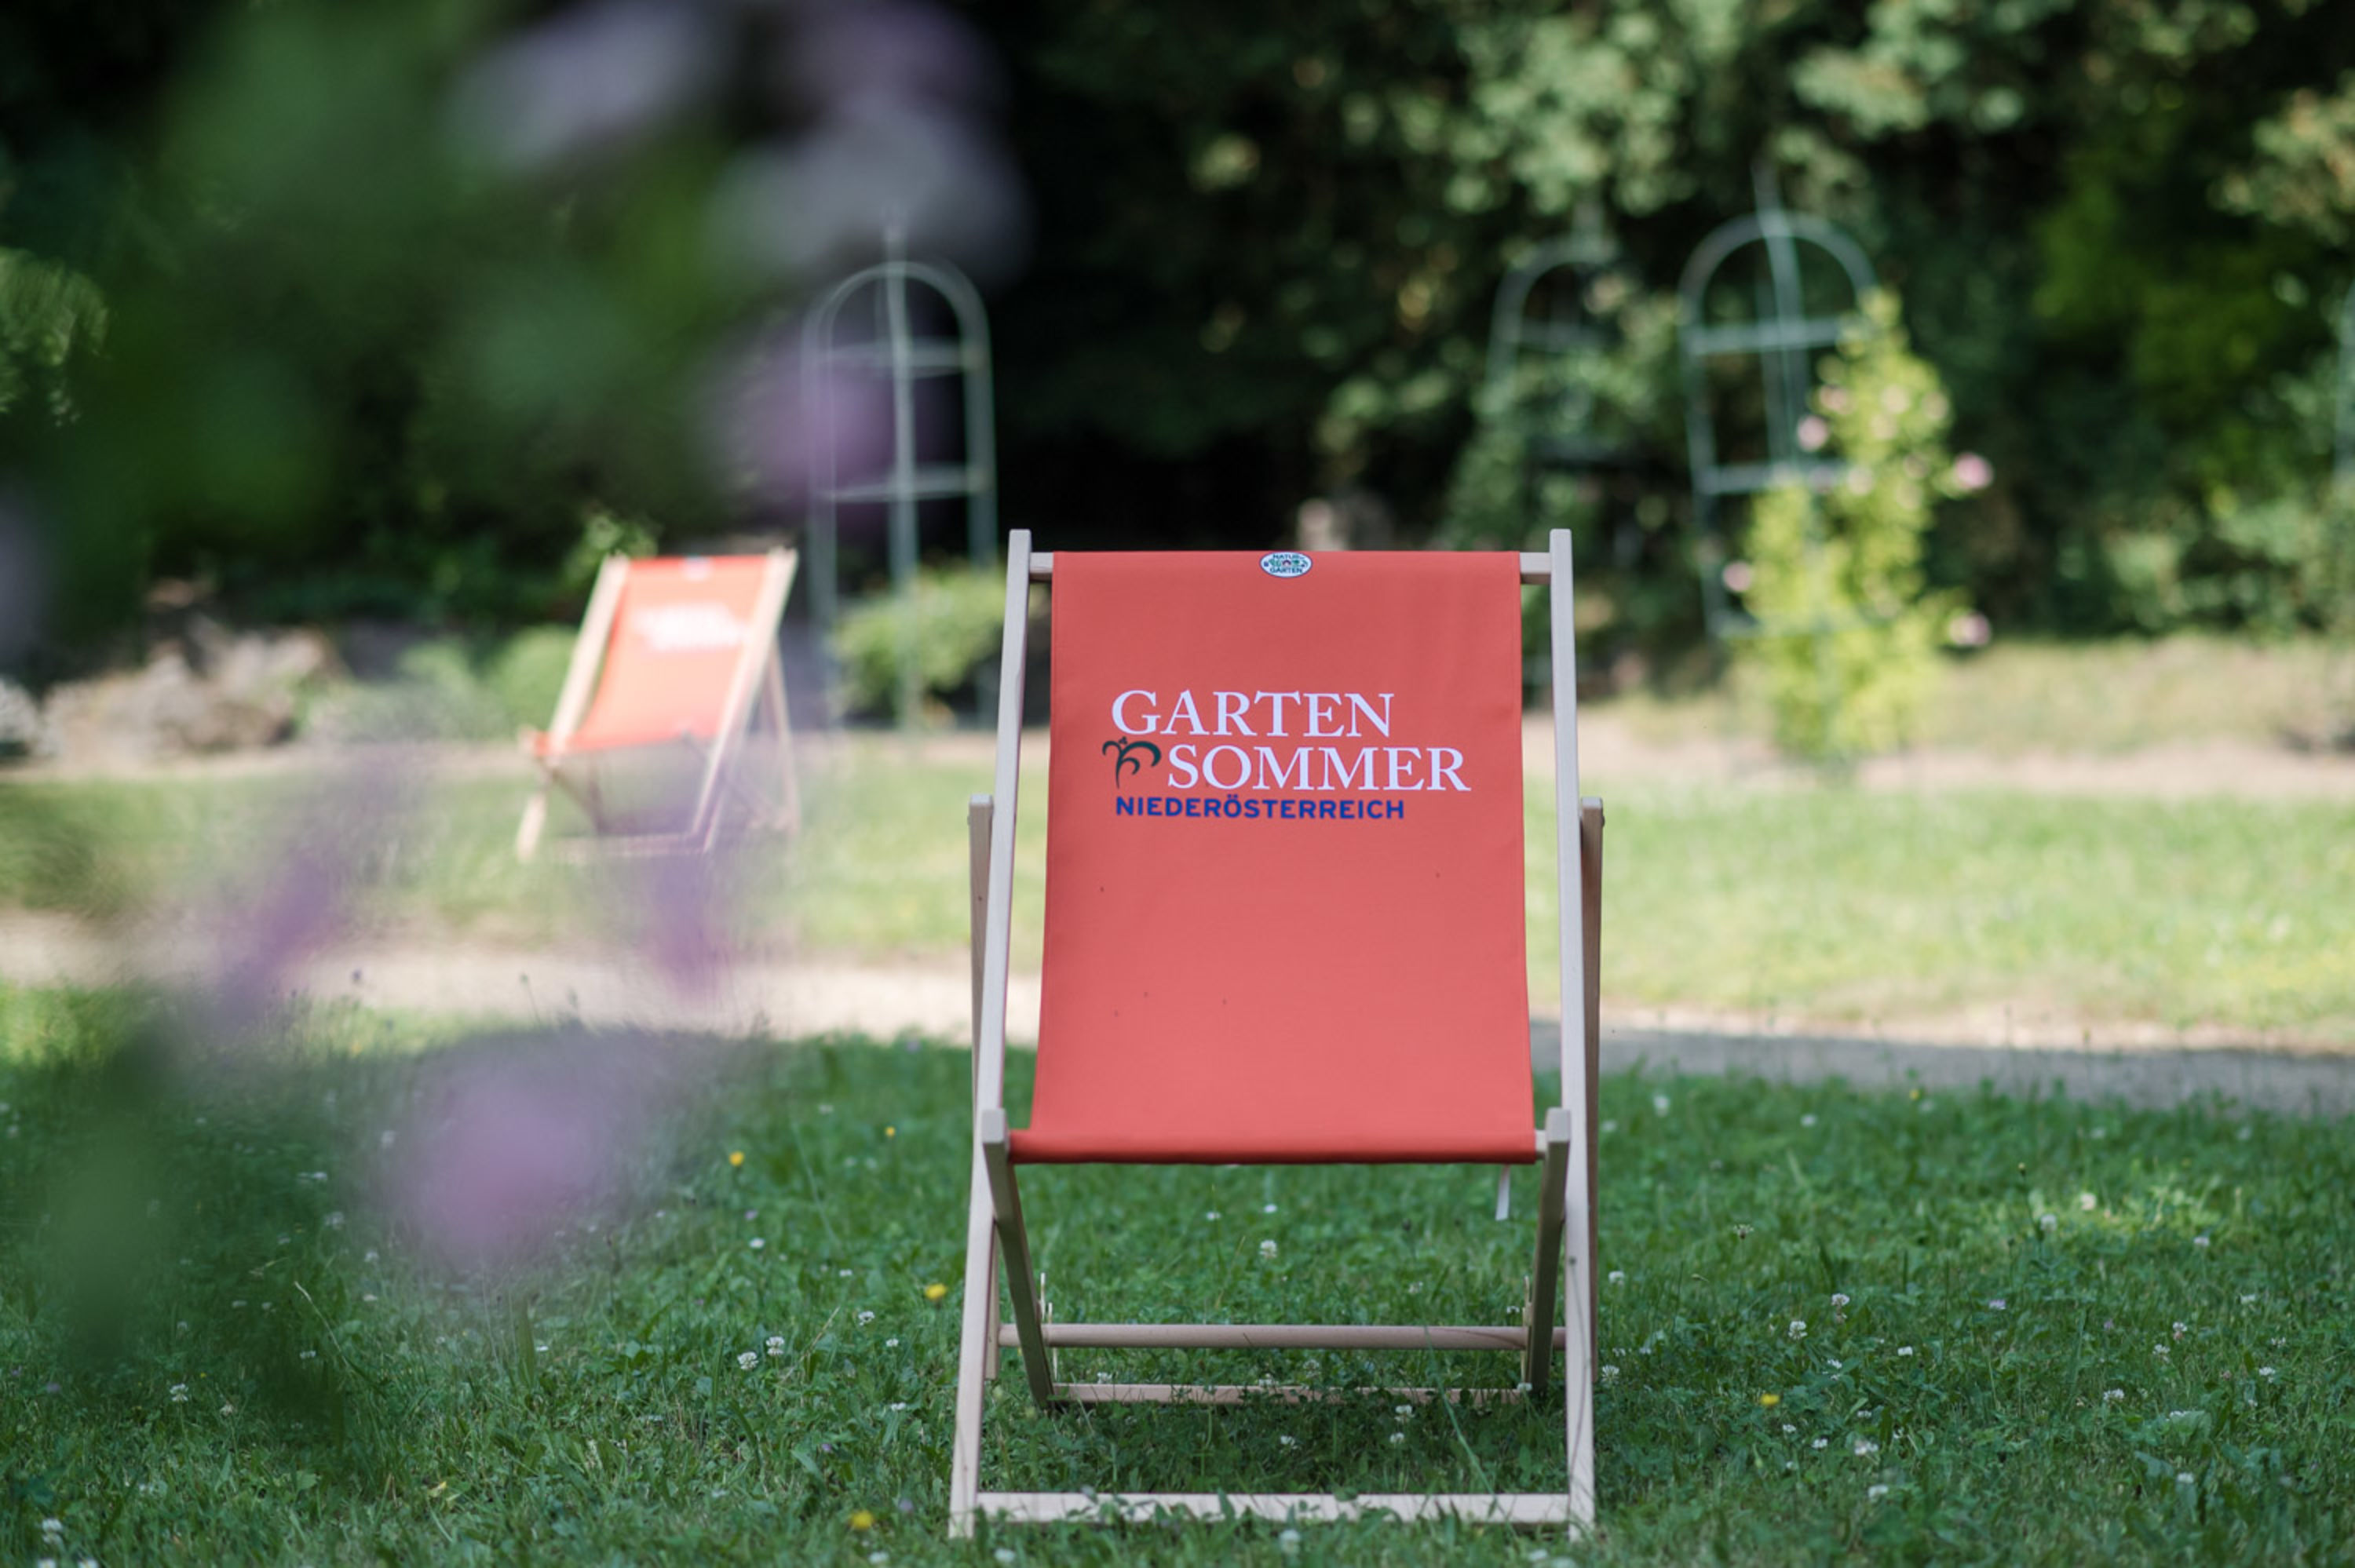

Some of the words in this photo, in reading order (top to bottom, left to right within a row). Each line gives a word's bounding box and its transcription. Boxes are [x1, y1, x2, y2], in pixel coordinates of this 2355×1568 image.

[1112, 690, 1394, 738] GARTEN
[1167, 744, 1472, 791] SOMMER
[1115, 794, 1404, 819] NIEDERÖSTERREICH
